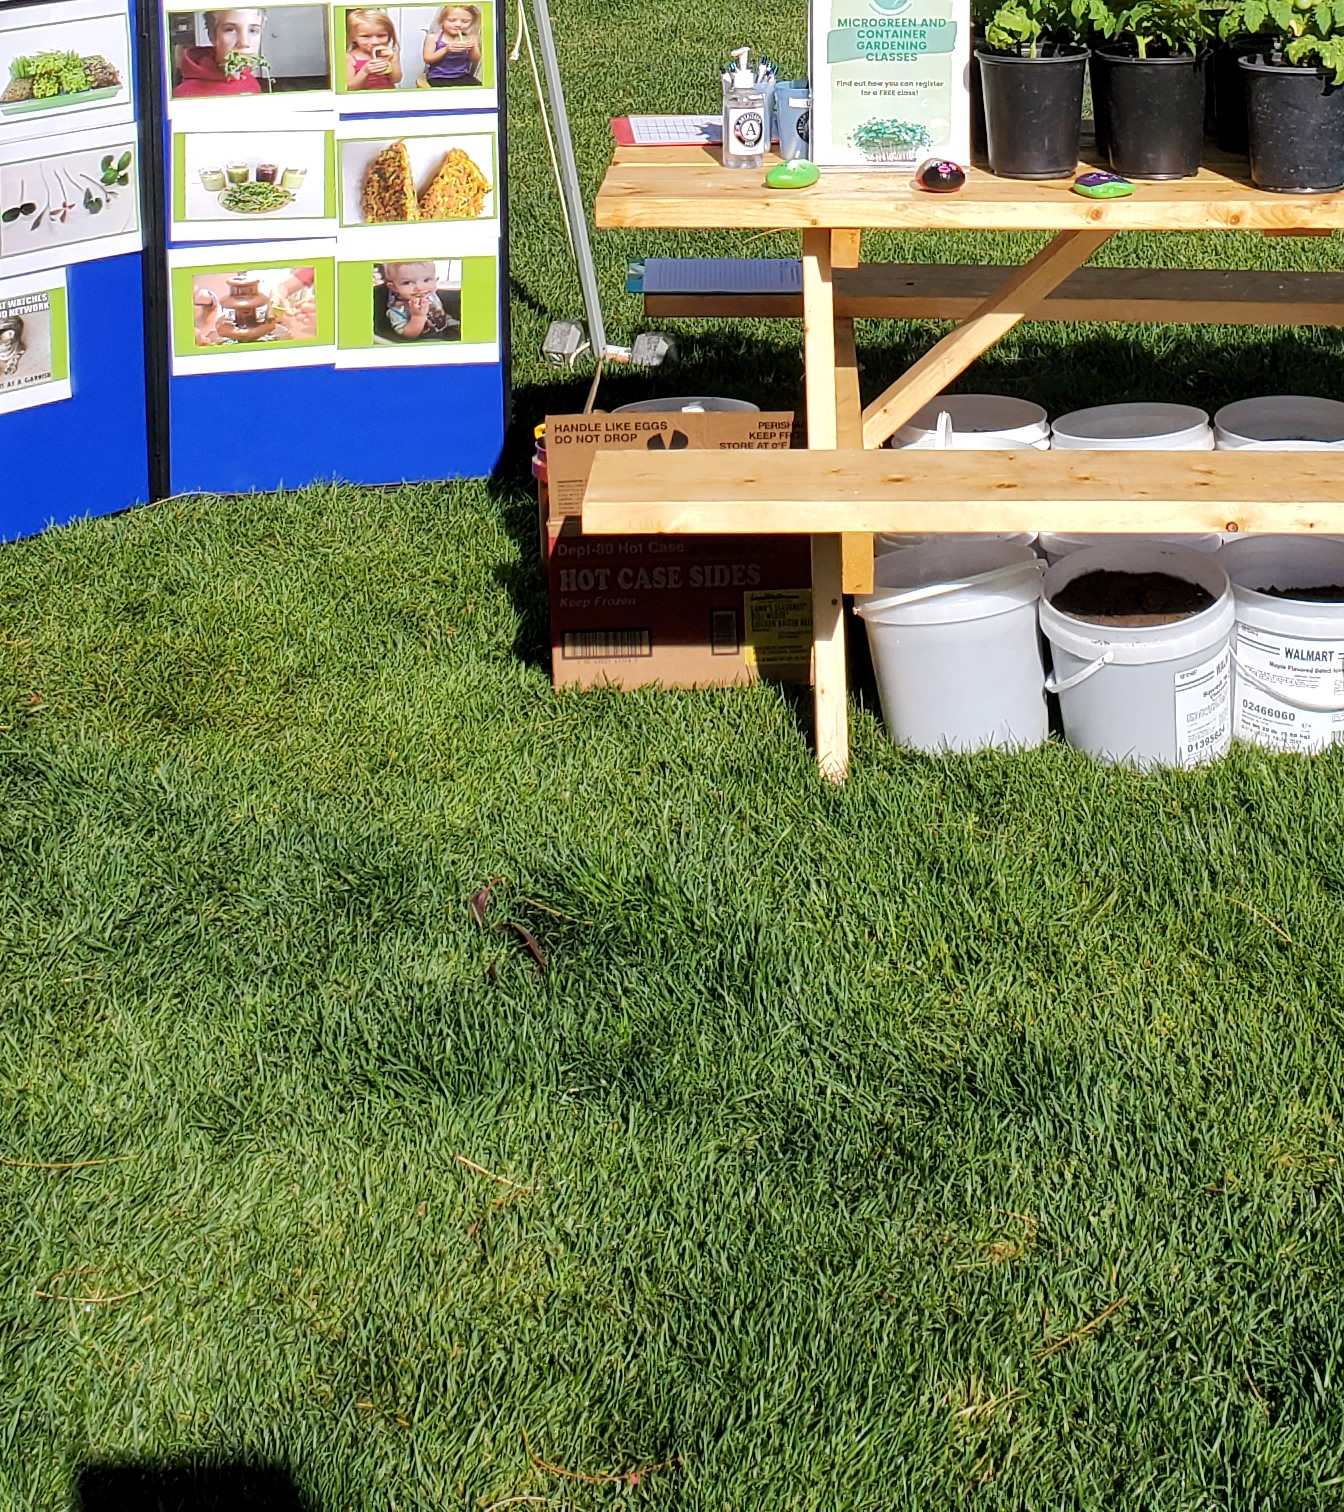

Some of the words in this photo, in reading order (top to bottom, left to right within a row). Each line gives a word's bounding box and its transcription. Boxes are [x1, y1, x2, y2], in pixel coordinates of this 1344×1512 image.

[837, 18, 917, 28] MICROGREEN
[920, 18, 946, 28] AND
[857, 29, 927, 39] CONTAINER
[856, 41, 927, 50] GARDENING
[866, 52, 918, 62] CLASSES
[885, 81, 899, 89] you
[915, 80, 944, 88] register
[7, 292, 48, 309] WATCHES
[8, 301, 50, 317] NETWORK
[554, 422, 602, 433] HANDLE
[605, 421, 631, 432] LIKE
[634, 421, 668, 431] EGGS
[555, 434, 572, 445] DO
[576, 434, 601, 444] NOT
[604, 433, 638, 443] DROP
[749, 431, 776, 440] KEEP
[719, 442, 754, 450] STORE
[758, 442, 770, 450] AT
[618, 541, 644, 555] Hot
[648, 541, 685, 554] Case
[559, 569, 611, 592] HOT
[617, 566, 683, 590] CASE
[689, 564, 762, 587] SIDES
[559, 597, 591, 609] Keep
[593, 595, 636, 608] Frozen
[1284, 646, 1335, 662] WALMART
[1242, 698, 1296, 722] 02466060
